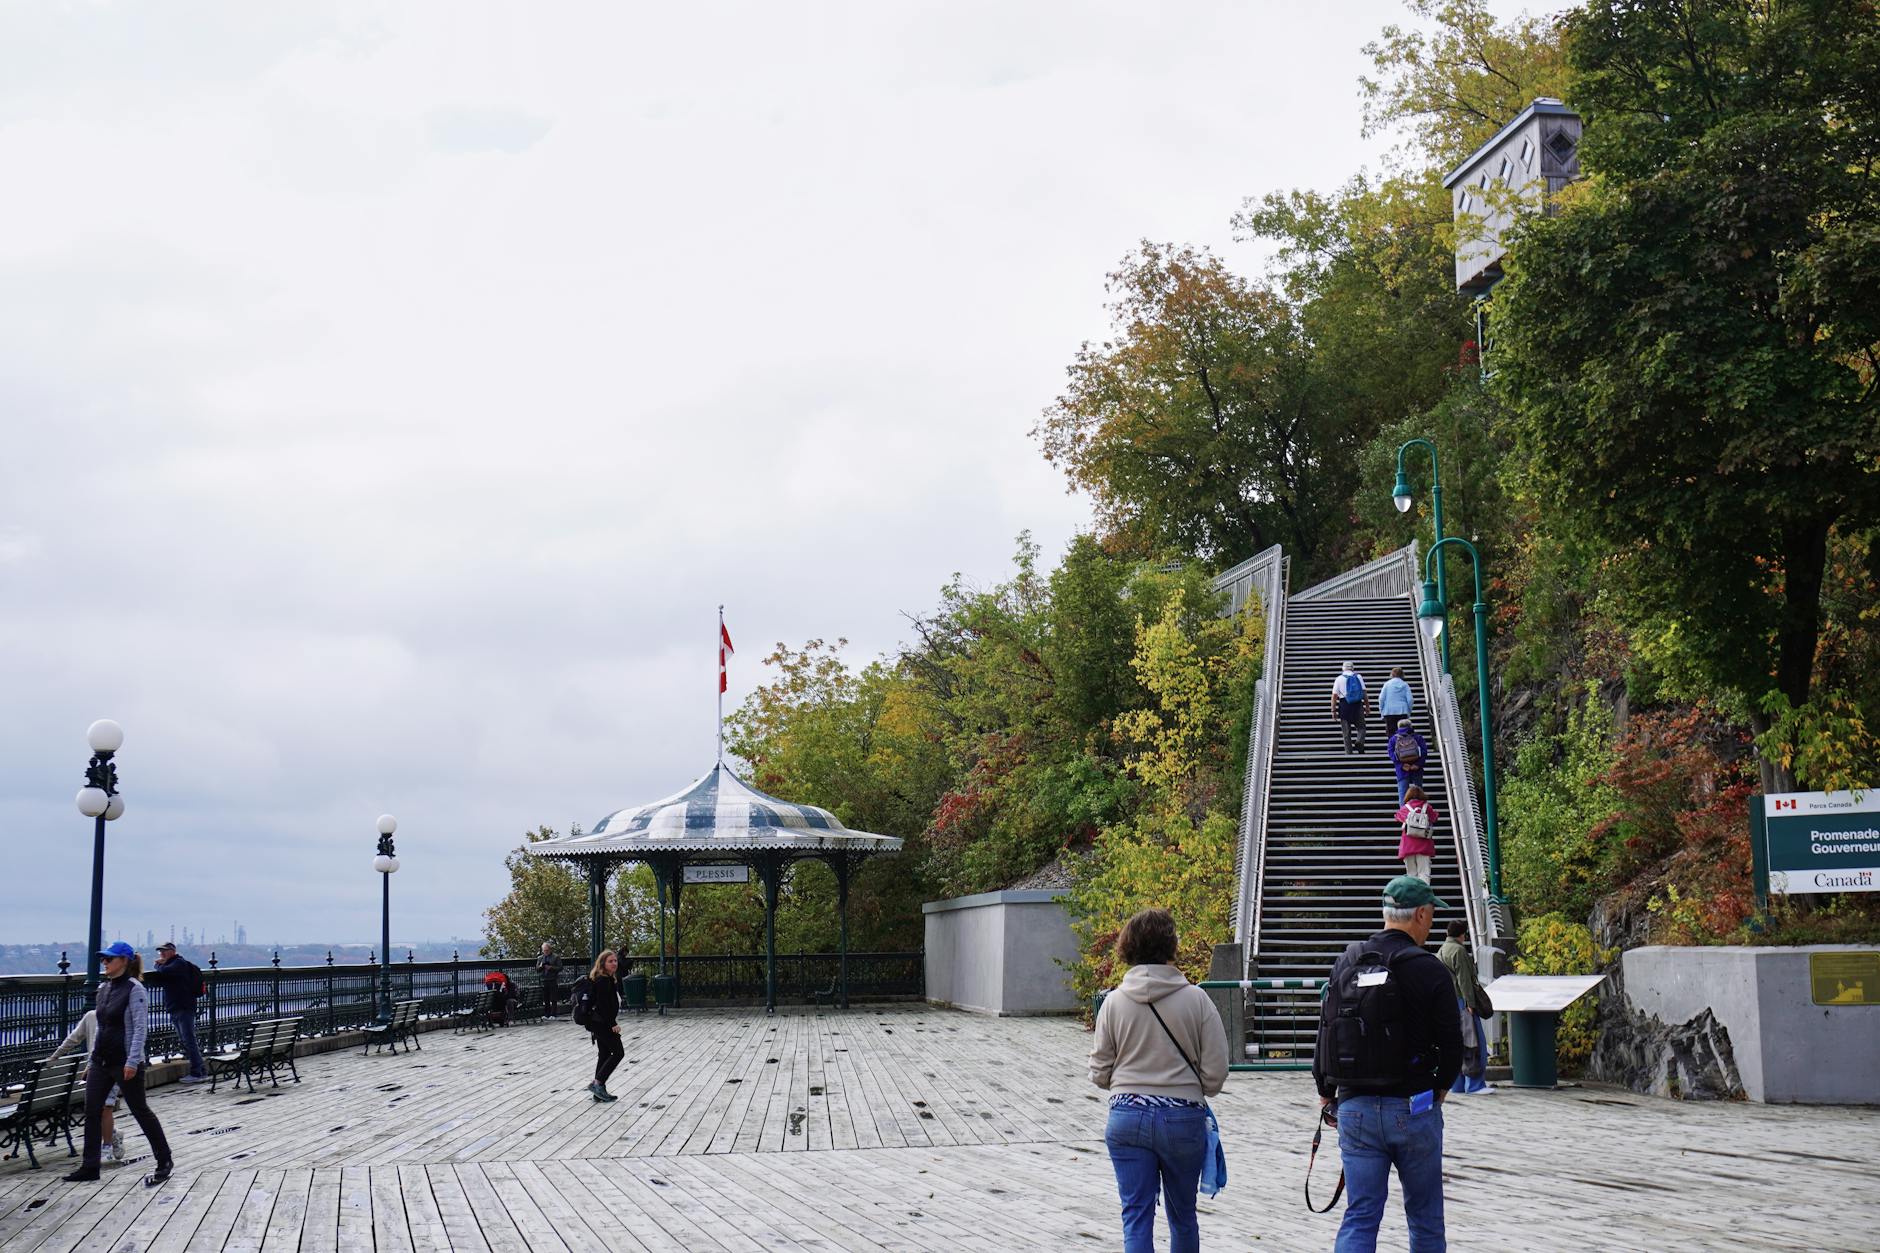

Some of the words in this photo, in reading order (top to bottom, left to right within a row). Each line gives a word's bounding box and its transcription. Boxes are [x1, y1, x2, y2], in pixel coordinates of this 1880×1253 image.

[1810, 828, 1880, 841] Promenade
[696, 870, 735, 878] PLESSIS
[1814, 872, 1872, 888] Canada
